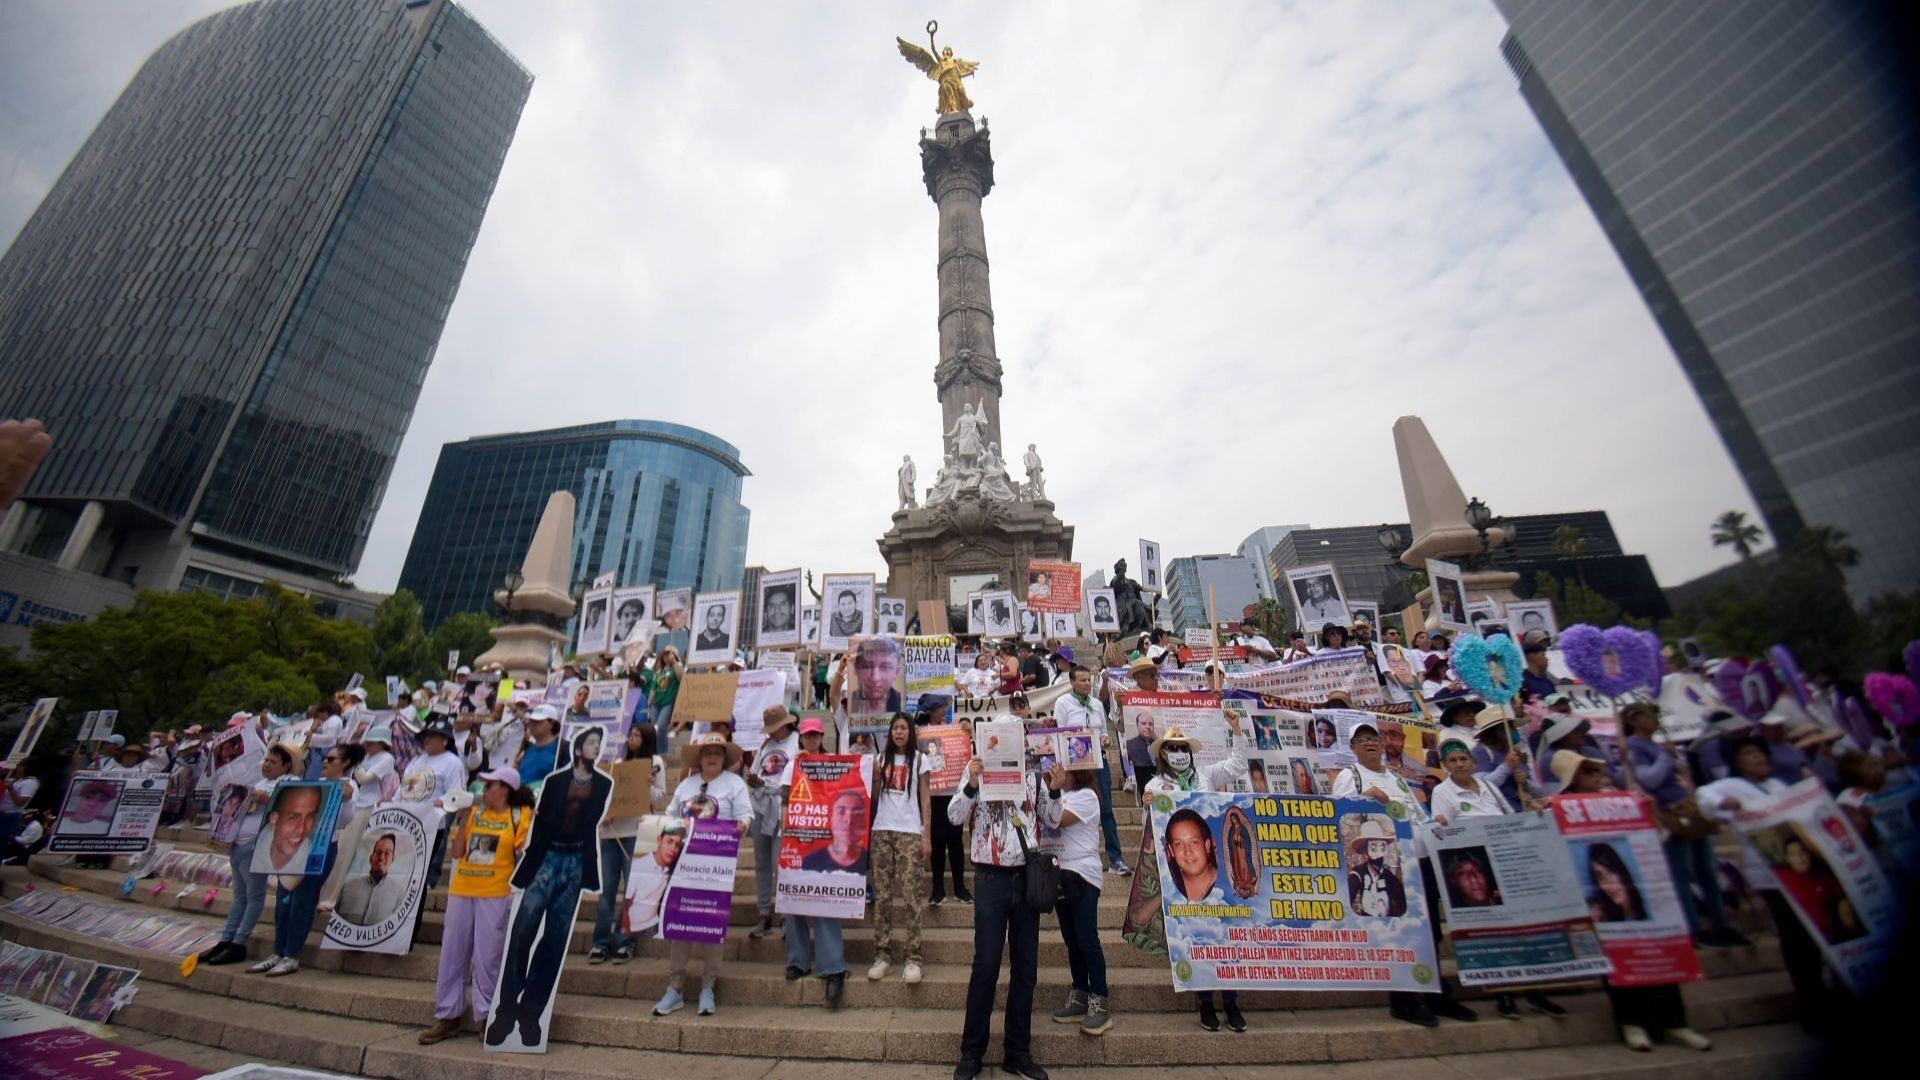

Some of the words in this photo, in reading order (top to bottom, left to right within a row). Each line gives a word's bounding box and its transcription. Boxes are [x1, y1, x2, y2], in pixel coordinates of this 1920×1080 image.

[762, 575, 799, 585] DESAPARECIDO
[1290, 568, 1331, 579] DESAPARECIDO
[906, 648, 951, 664] BAVERA
[1160, 697, 1181, 706] ESTA
[1182, 698, 1192, 706] MI
[1193, 698, 1217, 707] HIJO?
[849, 718, 868, 727] Delia
[788, 803, 802, 814] LO
[805, 804, 828, 815] HAS
[1253, 798, 1278, 817] NO
[1280, 799, 1335, 819] TENGO
[1560, 799, 1586, 823] SE
[1582, 796, 1641, 822] BUSCA
[788, 815, 829, 827] VISTO?
[375, 811, 424, 860] ENCONTRARTE
[692, 832, 717, 840] Justicia
[1256, 823, 1303, 843] NADA
[1306, 824, 1340, 844] QUE
[1261, 848, 1340, 869] FESTEJAR
[680, 863, 711, 874] Horacio
[712, 865, 733, 876] Alain
[778, 883, 865, 897] DESAPARECIDO
[1271, 873, 1313, 894] ESTE
[1314, 874, 1337, 895] 10
[356, 920, 395, 942] VALLEJO
[396, 886, 418, 922] ADAME
[1270, 899, 1294, 920] DE
[1295, 900, 1344, 921] MAYO
[667, 922, 685, 932] ¡Hasta
[686, 925, 723, 936] encontrarte!
[1228, 927, 1248, 942] HACE
[1248, 927, 1257, 942] 16
[1258, 926, 1278, 942] AÑOS
[1279, 928, 1334, 943] SECUESTRARON
[1335, 929, 1340, 941] A
[1341, 929, 1351, 942] MI
[1352, 930, 1368, 943] HIJO
[1190, 945, 1205, 960] LUIS
[1205, 945, 1237, 960] ALBERTO
[1237, 946, 1266, 961] CALLEJA
[1266, 947, 1301, 961] MARTINEZ
[1303, 947, 1357, 962] DESAPARECIDO
[1358, 948, 1366, 962] EL
[1376, 949, 1395, 962] SEPT
[1395, 949, 1416, 963] 2010
[1216, 965, 1236, 980] NADA
[1236, 965, 1247, 980] ME
[1248, 966, 1278, 980] DETIENE
[1278, 966, 1298, 980] PARA
[1298, 966, 1325, 981] SEGUIR
[1325, 967, 1374, 981] BUSCANDOTE
[1374, 967, 1391, 981] HIJO
[1465, 970, 1504, 981] HASTA
